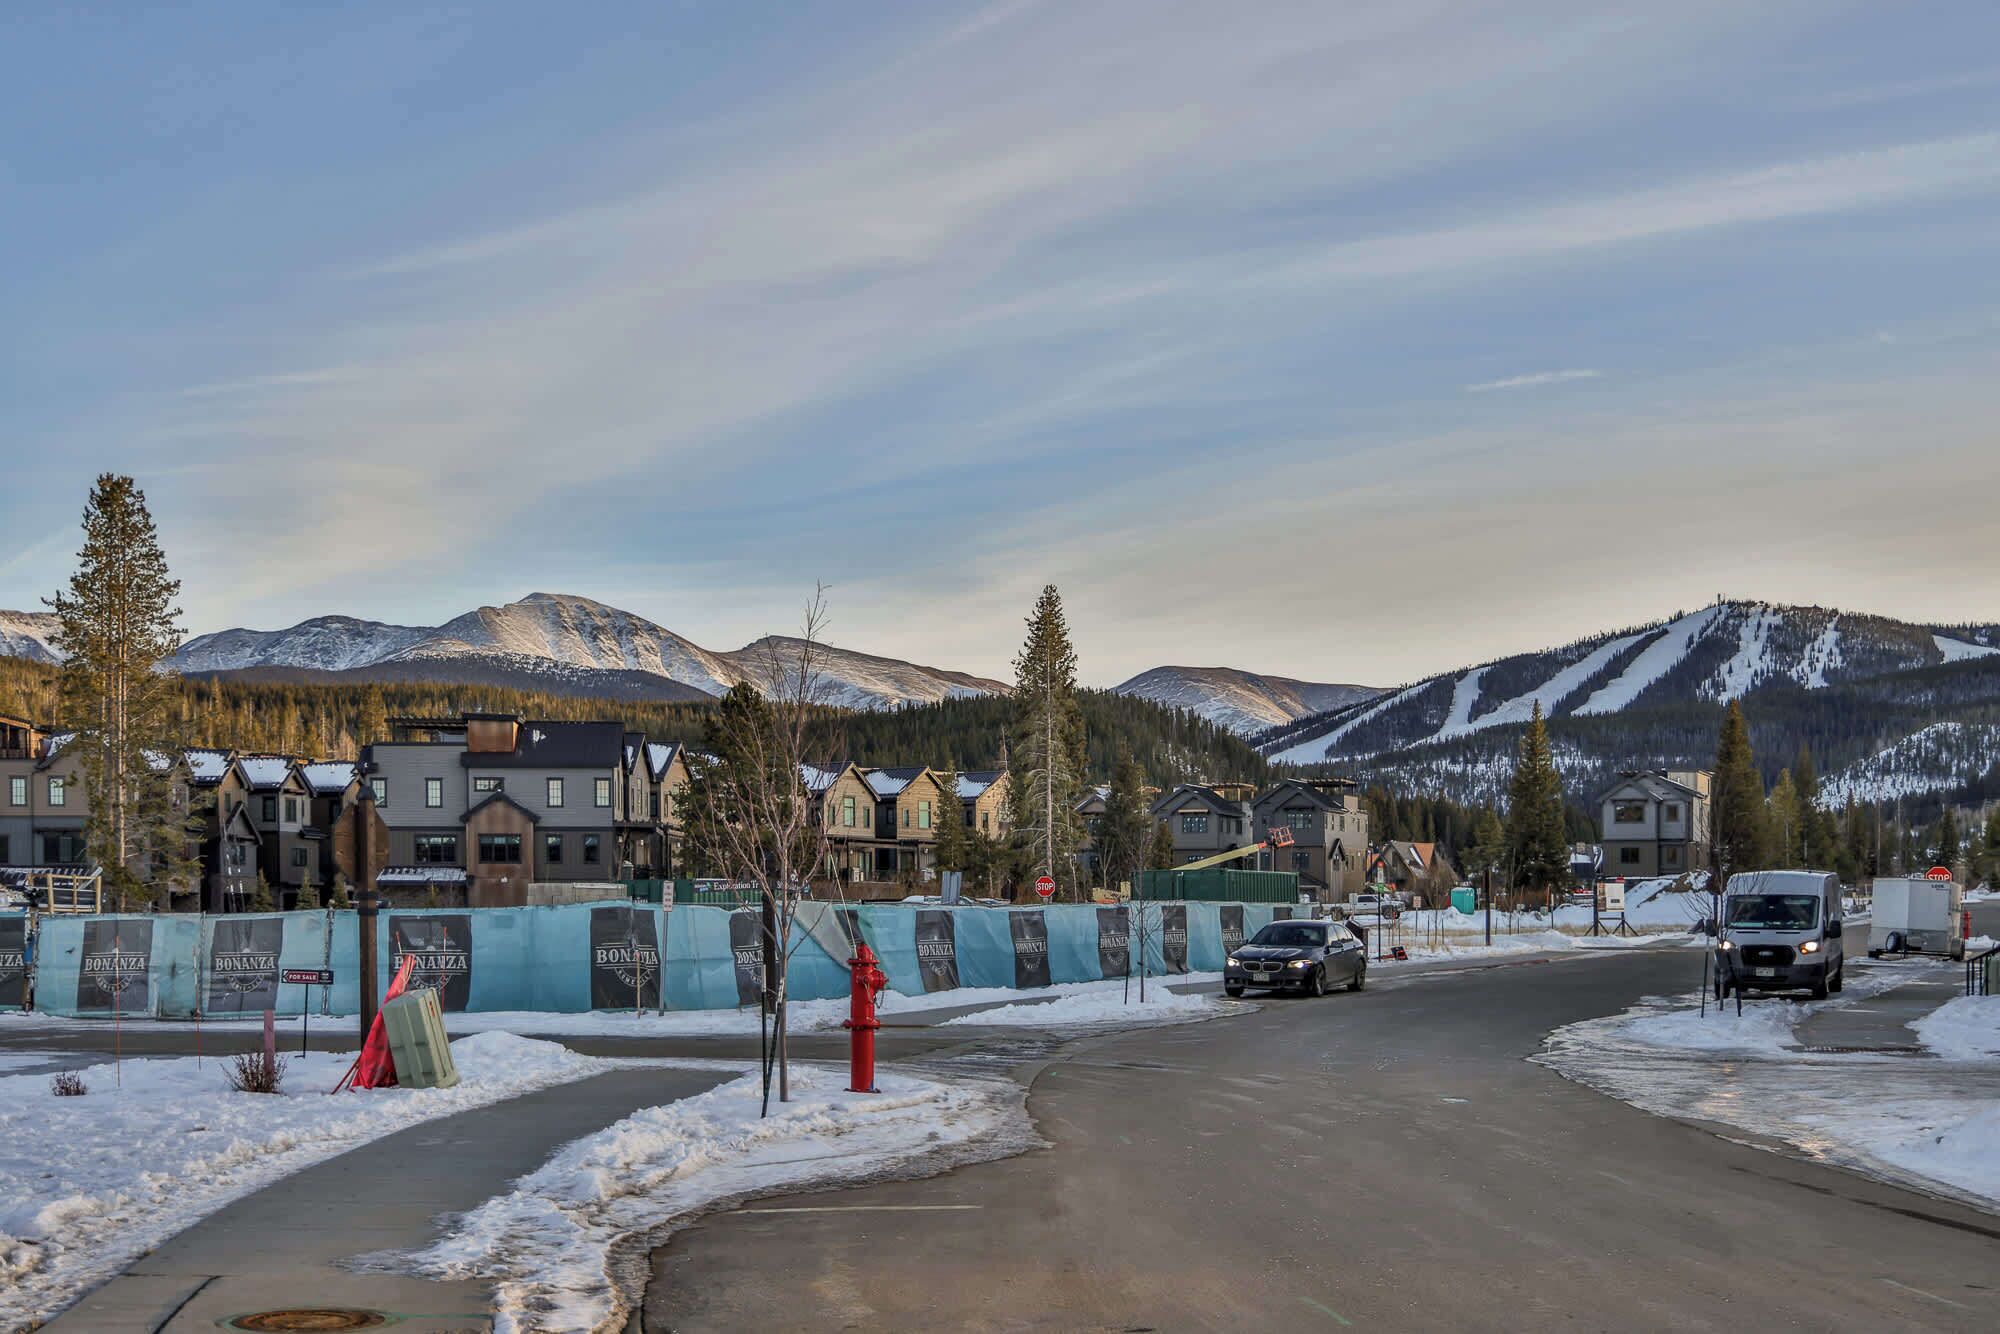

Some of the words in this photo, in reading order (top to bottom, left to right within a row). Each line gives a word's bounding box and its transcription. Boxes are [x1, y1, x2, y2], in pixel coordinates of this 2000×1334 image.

[713, 881, 750, 891] Explation
[1037, 882, 1054, 891] STOP
[918, 944, 954, 956] BONANZA
[1015, 942, 1047, 954] BONANZA
[85, 957, 145, 971] BONANZA
[215, 956, 276, 971] BONANZA
[394, 955, 468, 970] BNANZA
